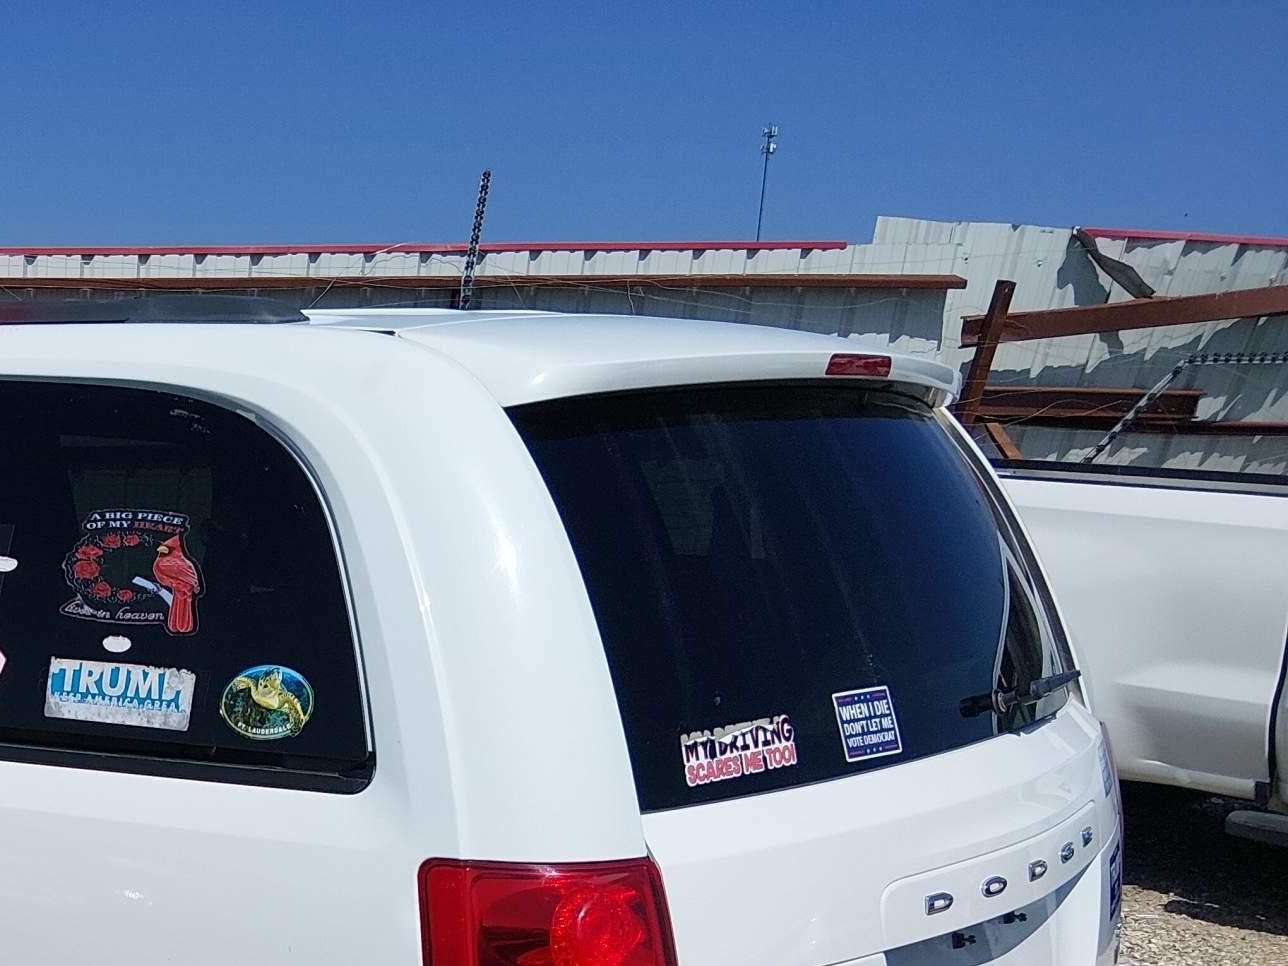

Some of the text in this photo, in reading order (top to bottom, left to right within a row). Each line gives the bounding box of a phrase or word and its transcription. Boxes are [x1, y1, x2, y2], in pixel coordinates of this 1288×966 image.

[86, 520, 184, 532] OF MY HEART
[91, 512, 101, 520] A
[137, 512, 184, 525] PIECE
[839, 703, 869, 720] WHEN
[873, 700, 890, 715] DIE
[248, 723, 292, 734] LAUDERDALE
[843, 716, 894, 735] DON'T LET ME
[684, 717, 793, 763] MY DRIVING
[847, 730, 895, 748] VOTE DEMOCRAT
[687, 743, 796, 784] SCARES ME TOO!
[924, 826, 1093, 916] DODGE
